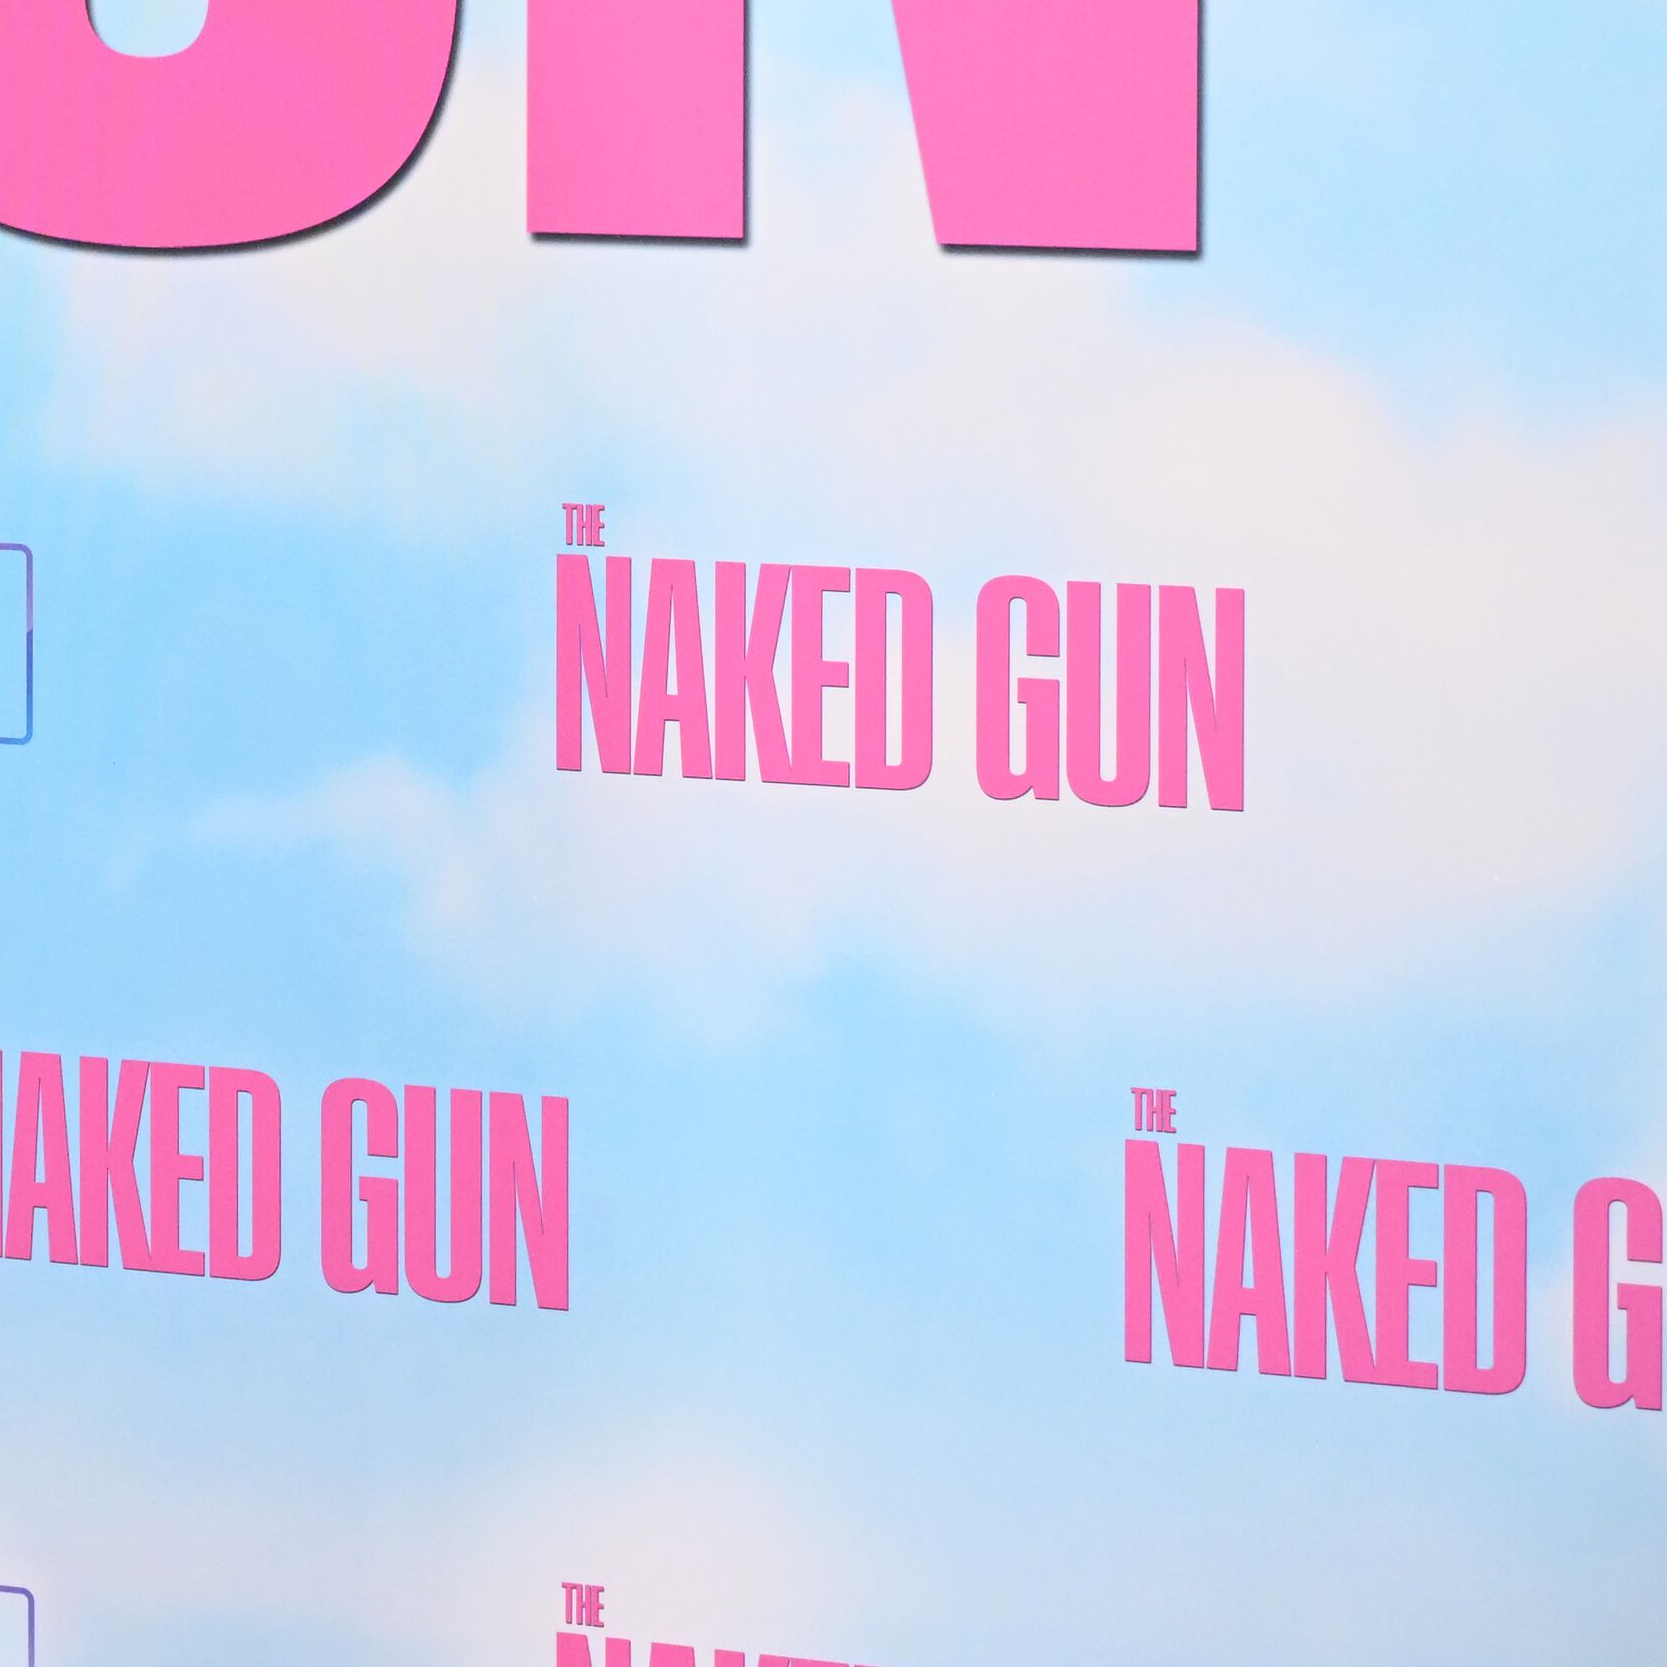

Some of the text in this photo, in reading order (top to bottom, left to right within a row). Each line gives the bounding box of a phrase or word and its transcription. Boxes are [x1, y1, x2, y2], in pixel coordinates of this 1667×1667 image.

[561, 502, 605, 546] THE
[555, 553, 1247, 813] NAKED GUN
[1130, 1086, 1178, 1134] THE
[320, 1077, 570, 1312] GUN
[1124, 1139, 1529, 1396] NAKED
[560, 1580, 606, 1628] THE
